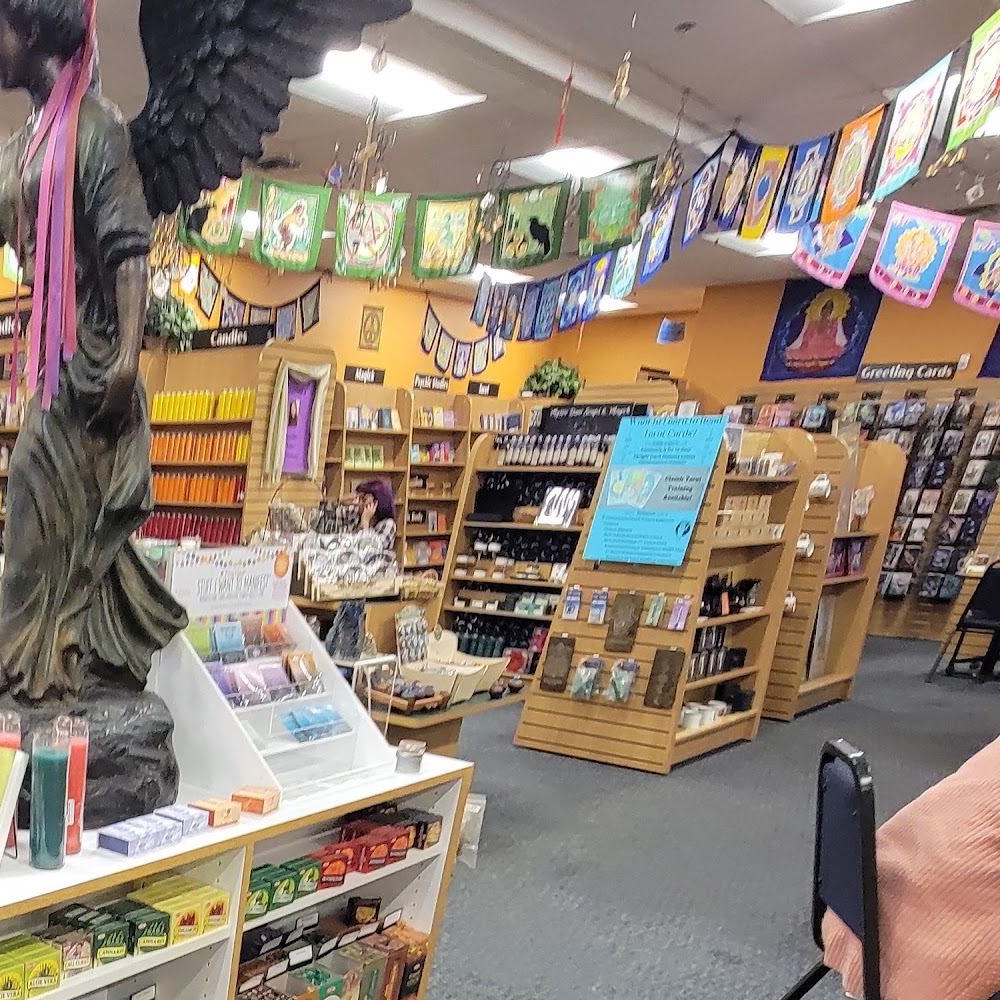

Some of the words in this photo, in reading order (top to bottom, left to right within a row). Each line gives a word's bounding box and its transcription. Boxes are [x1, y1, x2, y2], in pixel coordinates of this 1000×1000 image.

[210, 328, 248, 347] Candles
[860, 363, 915, 380] Greeting
[916, 364, 953, 378] Cards
[43, 976, 58, 985] VERA
[6, 990, 21, 999] VERA
